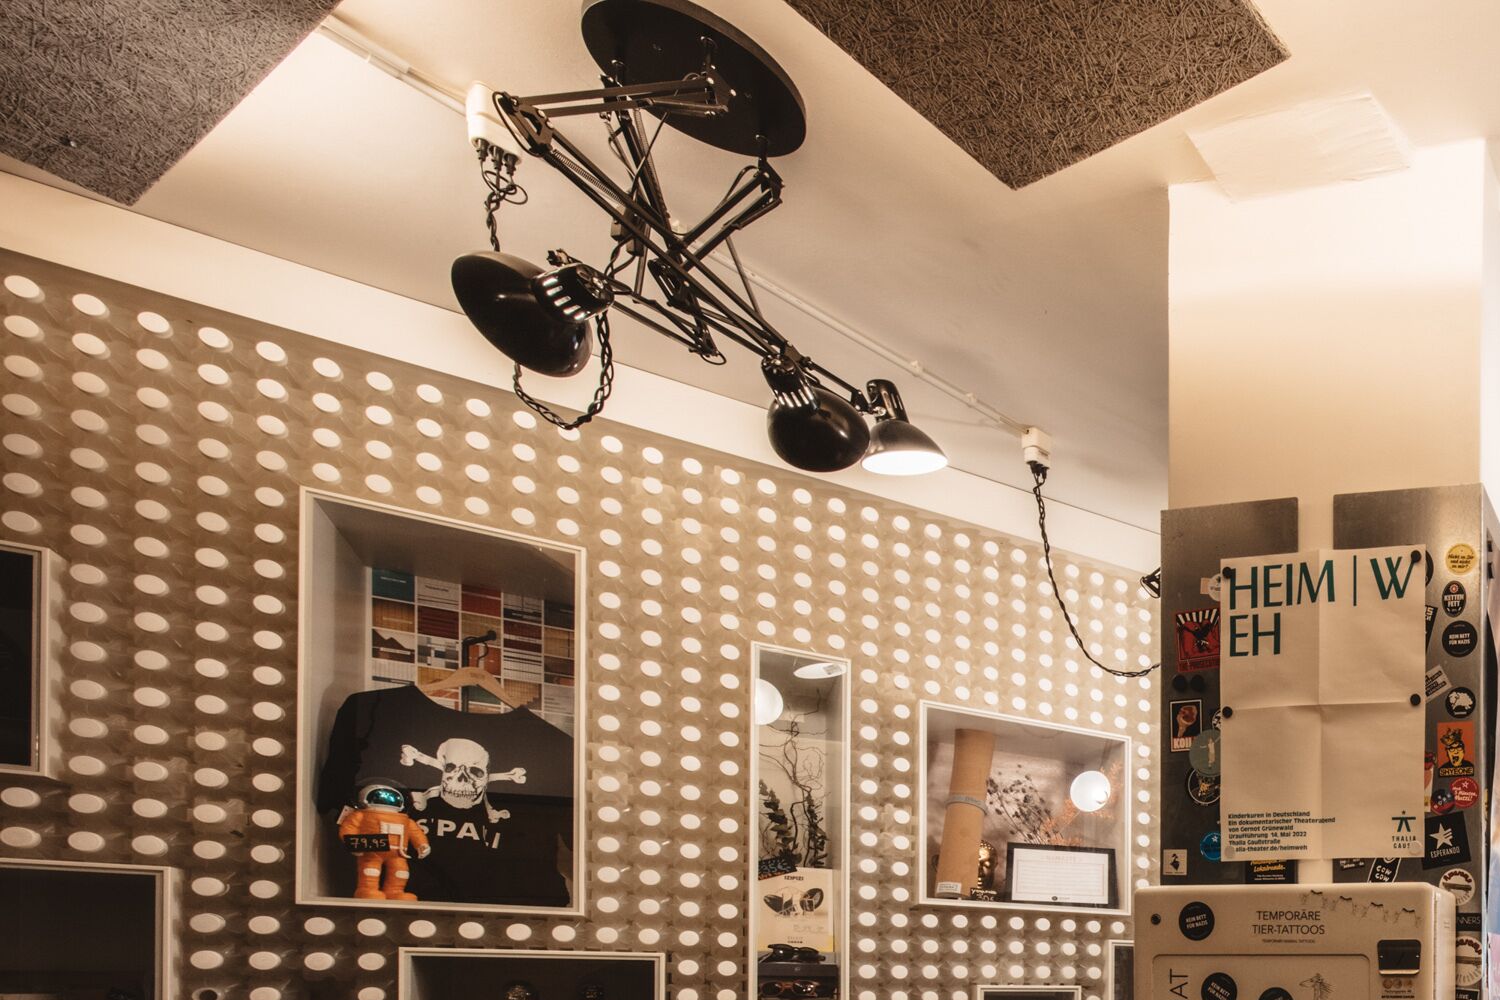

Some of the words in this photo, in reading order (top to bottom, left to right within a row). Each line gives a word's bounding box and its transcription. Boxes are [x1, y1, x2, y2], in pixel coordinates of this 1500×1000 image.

[1229, 560, 1335, 610] HEIM
[1370, 556, 1415, 600] W
[1229, 613, 1281, 657] EH
[1238, 818, 1292, 826] dokumentarischer
[351, 837, 387, 849] 79.95
[1430, 846, 1461, 859] ESPERANDO
[1256, 908, 1321, 921] TEMPORÄRE
[1252, 924, 1325, 935] TIER-TATTOOS
